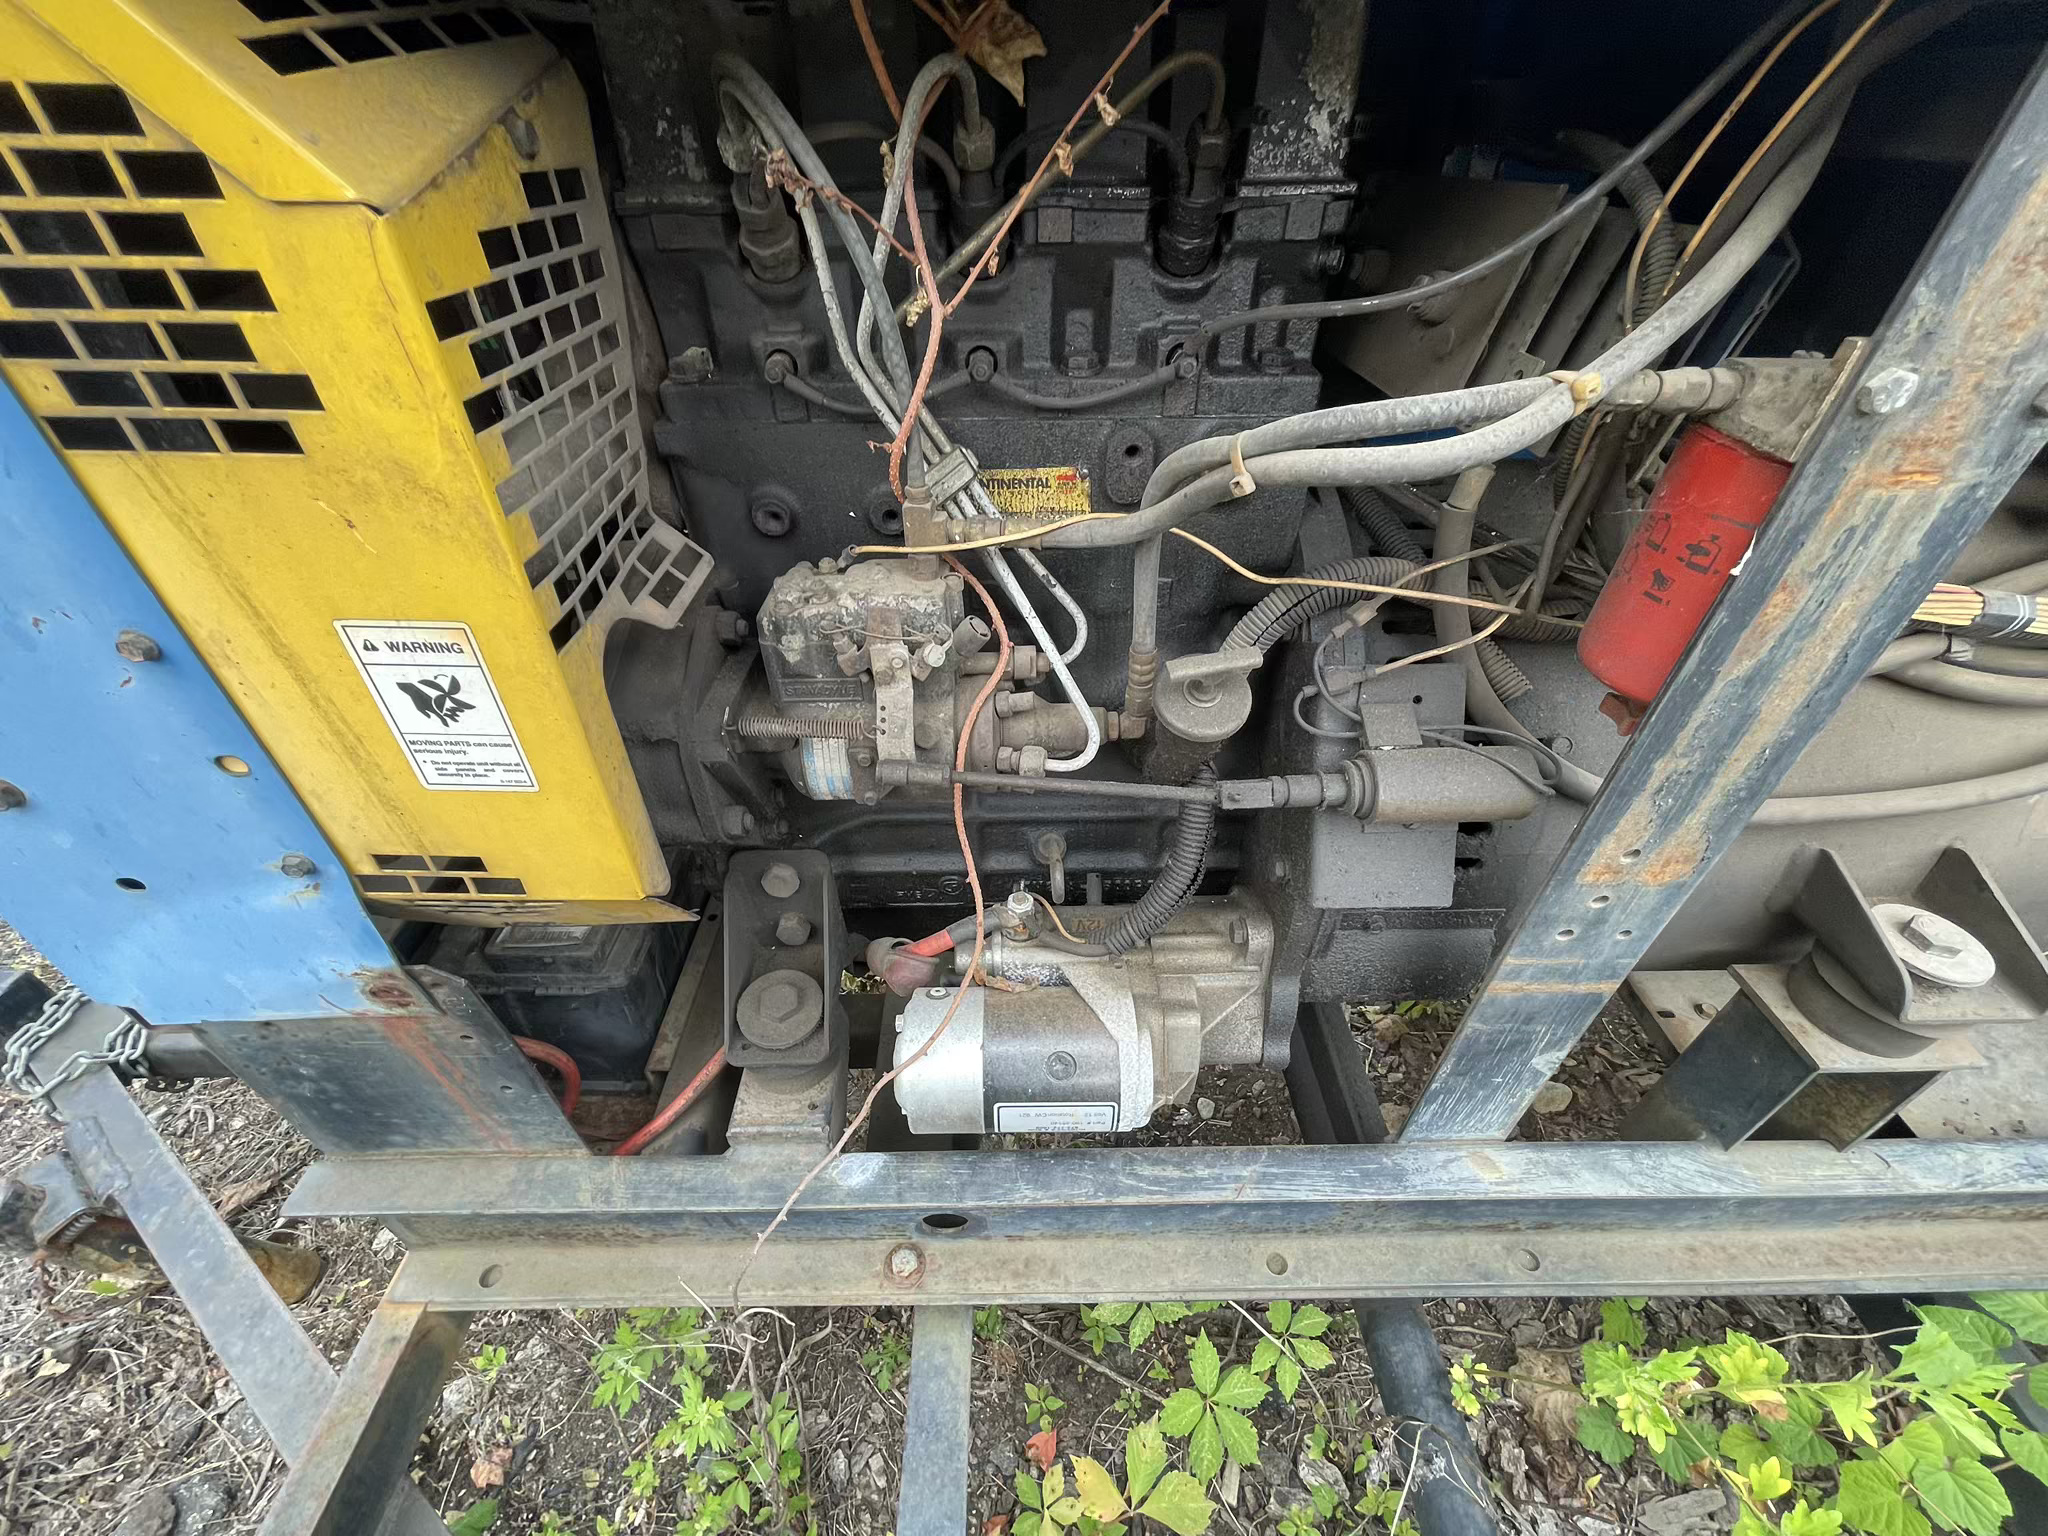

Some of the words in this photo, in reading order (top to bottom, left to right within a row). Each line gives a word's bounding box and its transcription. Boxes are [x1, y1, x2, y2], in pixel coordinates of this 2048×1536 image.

[979, 477, 1051, 490] NTINENTAL
[383, 641, 464, 654] WARNING
[408, 739, 443, 747] MOVING
[445, 748, 469, 756] injury.
